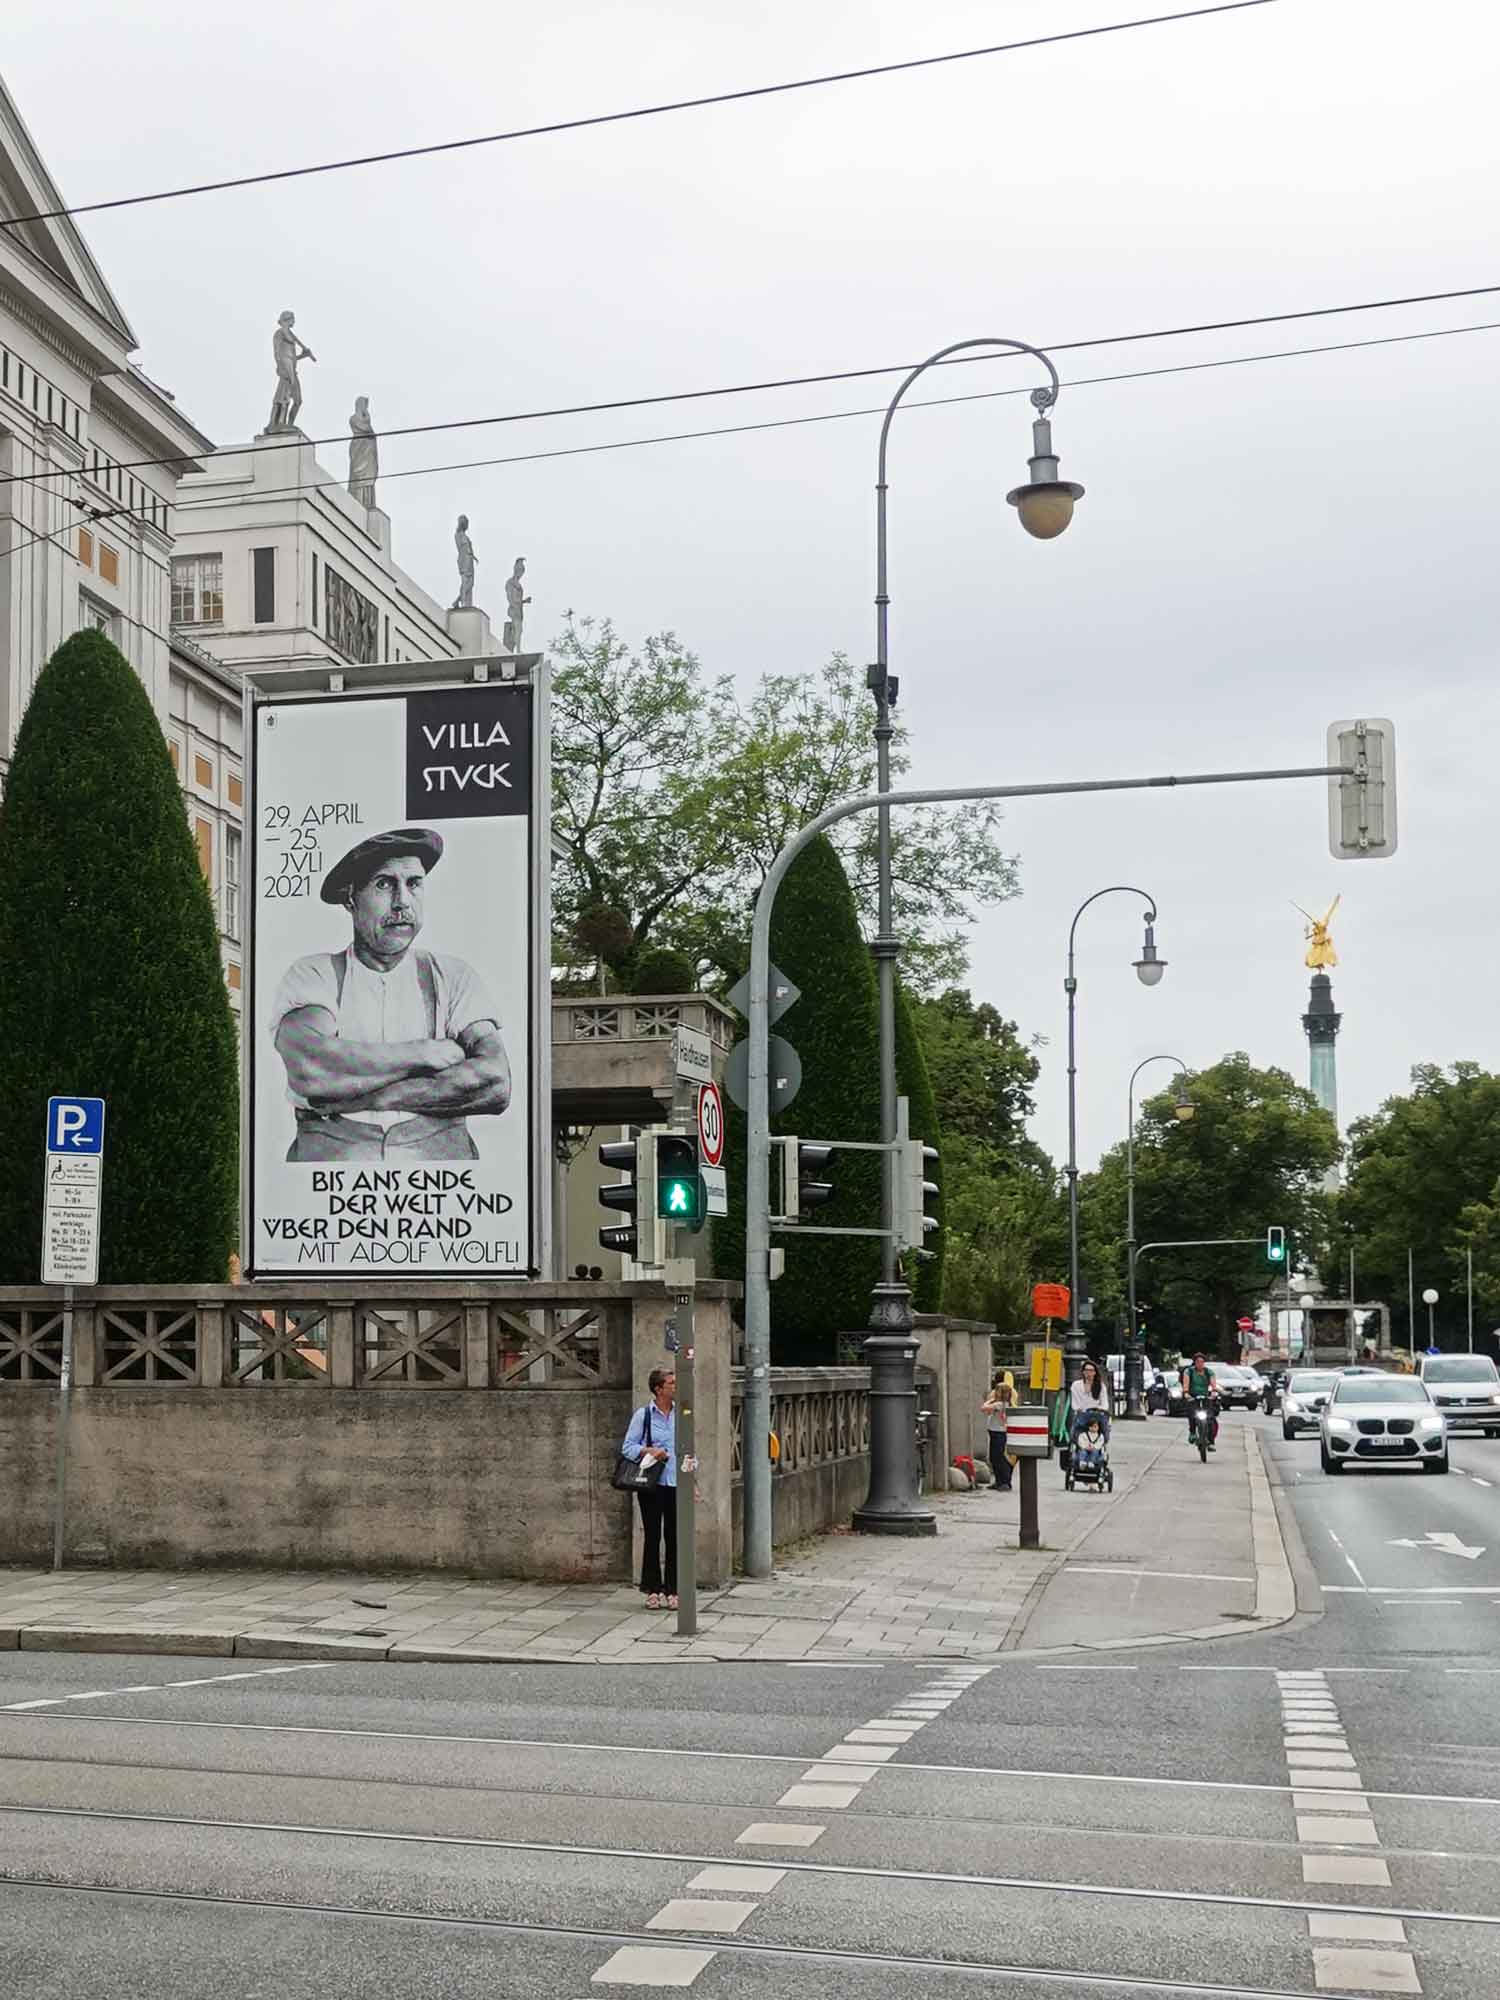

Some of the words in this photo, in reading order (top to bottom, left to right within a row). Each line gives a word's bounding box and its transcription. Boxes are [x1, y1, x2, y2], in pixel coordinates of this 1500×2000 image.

[422, 721, 511, 750] VILLA
[422, 762, 513, 792] STVCK
[264, 805, 292, 829] 29.
[301, 803, 364, 826] APRIL
[290, 828, 320, 850] 25.
[280, 852, 323, 874] JVLI
[264, 875, 311, 898] 2021
[56, 1105, 87, 1146] P
[703, 1102, 719, 1141] 30
[312, 1170, 344, 1192] BIS
[351, 1170, 401, 1192] ANS
[408, 1169, 476, 1191] ENDE
[329, 1194, 377, 1216] DER
[384, 1193, 447, 1215] WELT
[456, 1193, 513, 1215] VND
[338, 1219, 388, 1240] DEN
[397, 1217, 473, 1239] RAND
[298, 1241, 341, 1264] MIT
[350, 1242, 430, 1264] ADOLF
[438, 1240, 519, 1264] WÖLFLI
